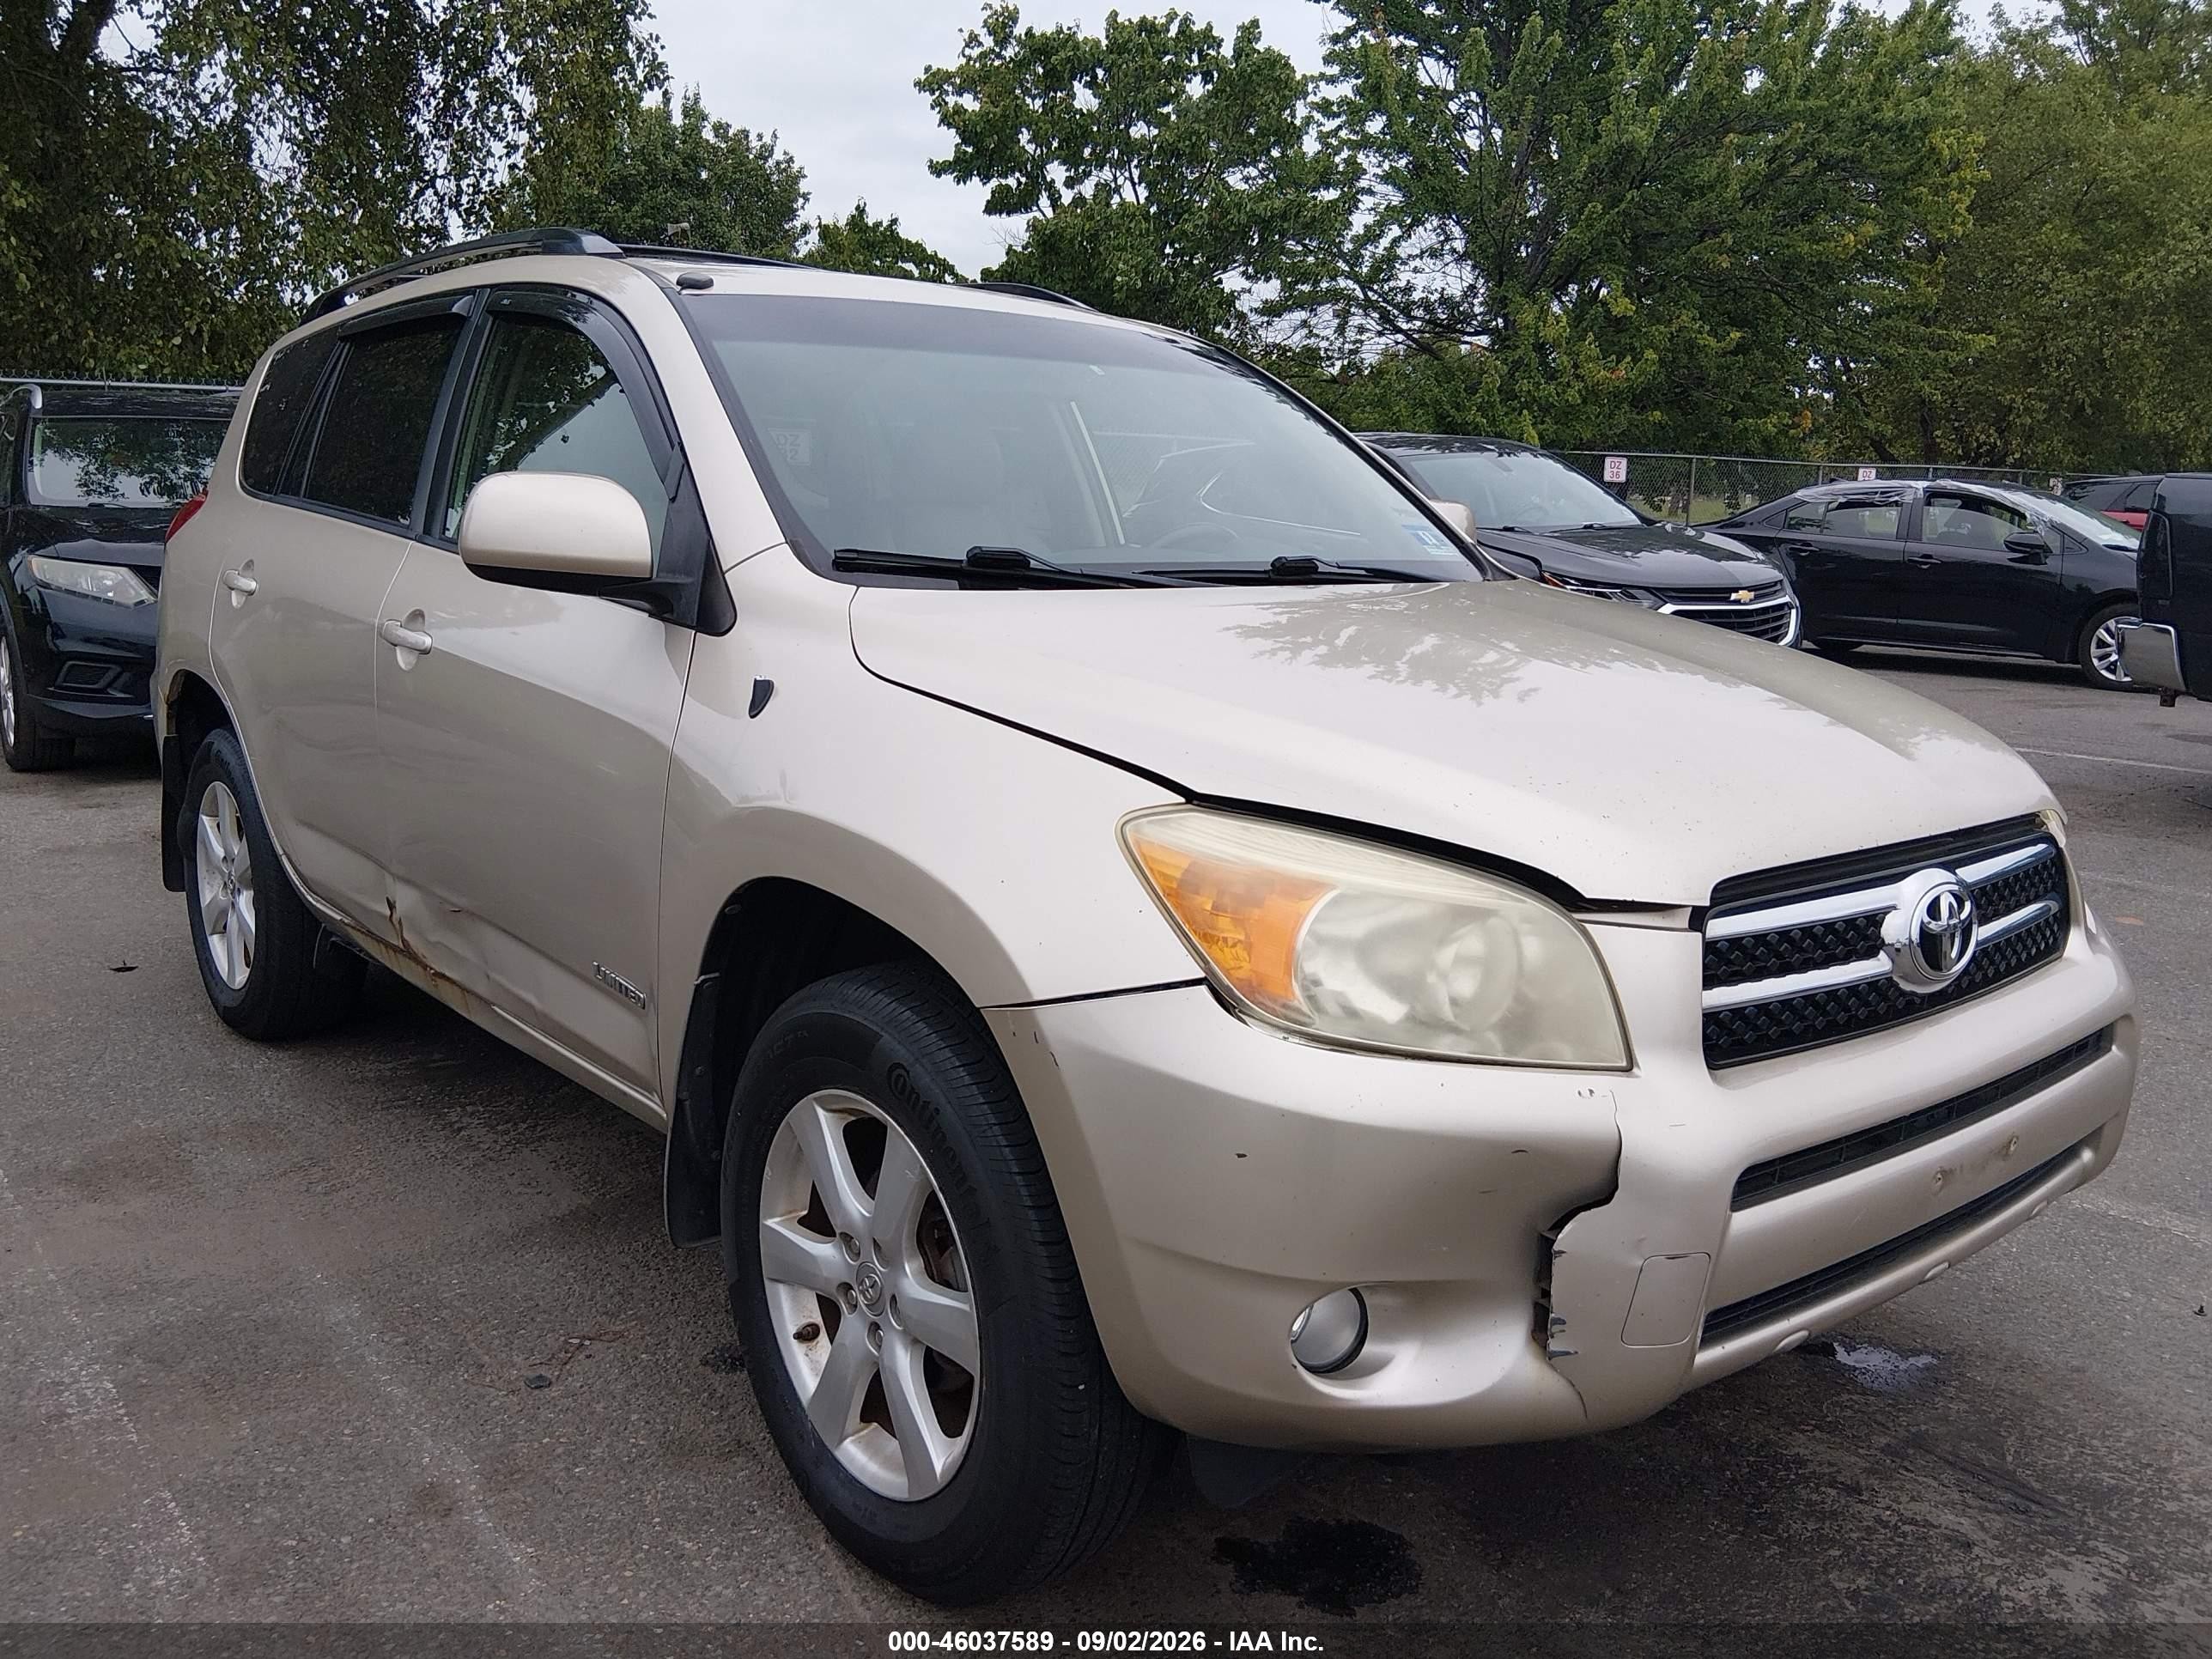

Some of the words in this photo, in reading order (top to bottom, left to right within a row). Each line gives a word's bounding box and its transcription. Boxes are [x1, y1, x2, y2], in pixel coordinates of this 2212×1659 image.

[1609, 460, 1622, 470] DZ
[1609, 470, 1620, 479] 36
[1863, 470, 1872, 478] DZ
